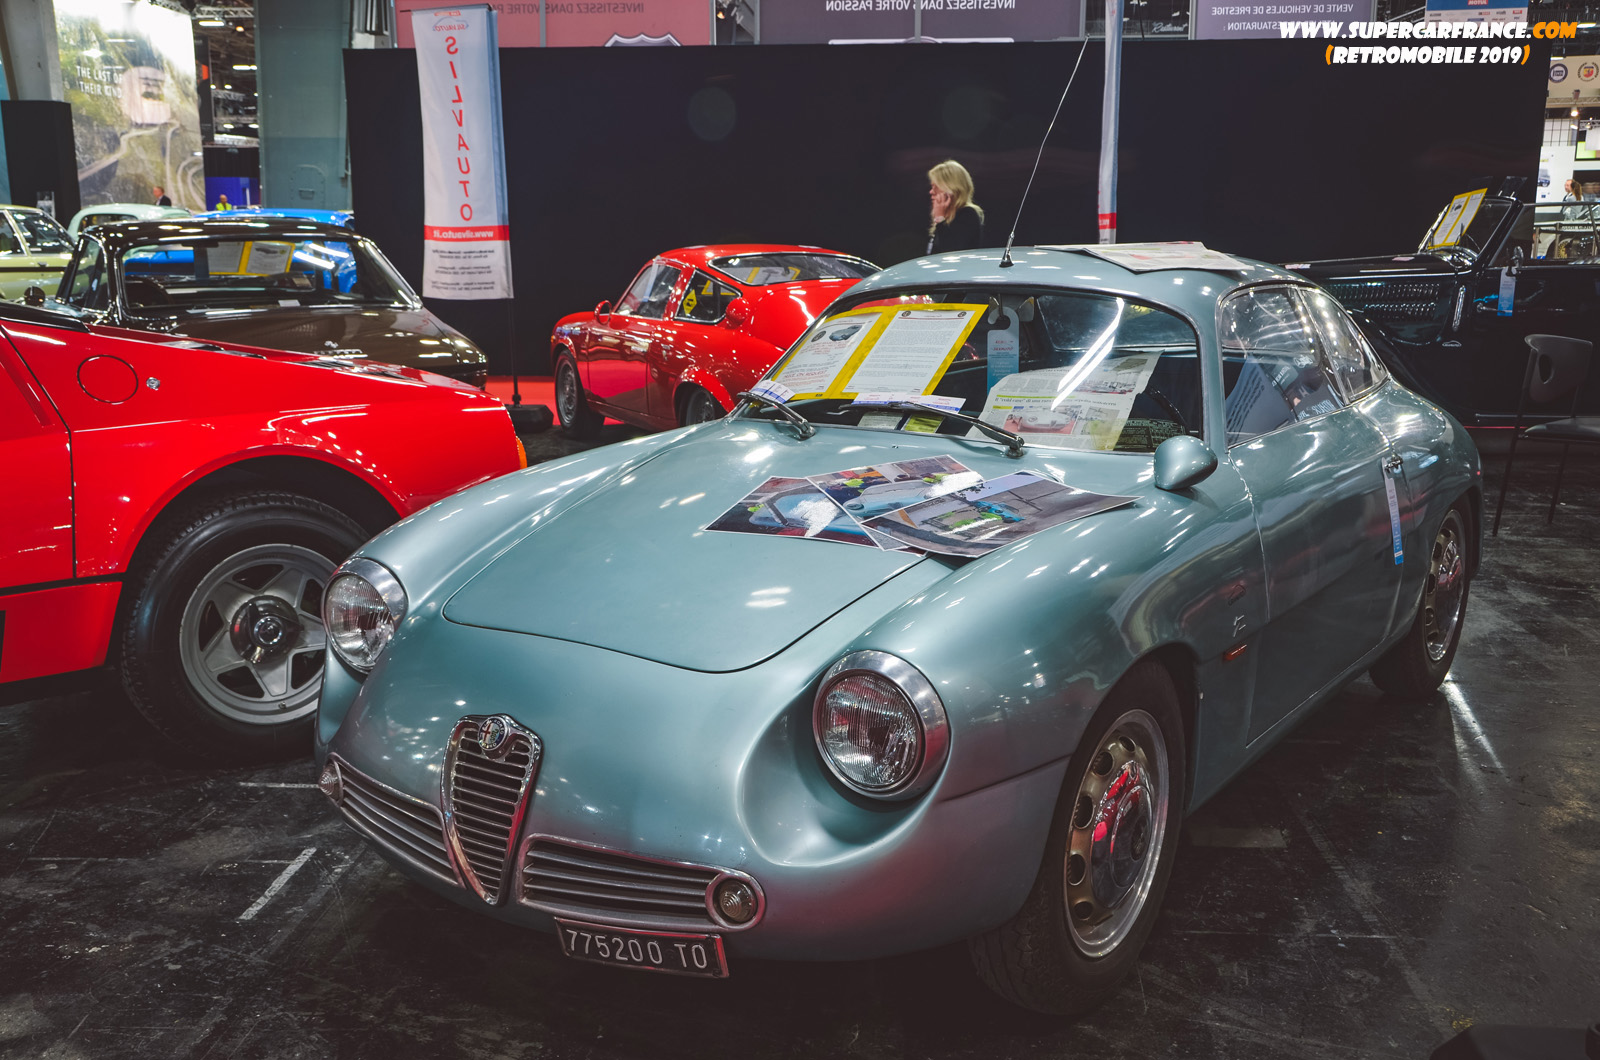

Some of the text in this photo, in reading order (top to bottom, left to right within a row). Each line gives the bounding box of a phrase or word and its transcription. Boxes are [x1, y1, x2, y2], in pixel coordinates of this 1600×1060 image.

[76, 65, 91, 79] THE
[93, 68, 111, 82] LAST
[80, 81, 102, 96] THEIR
[566, 929, 663, 965] 775200
